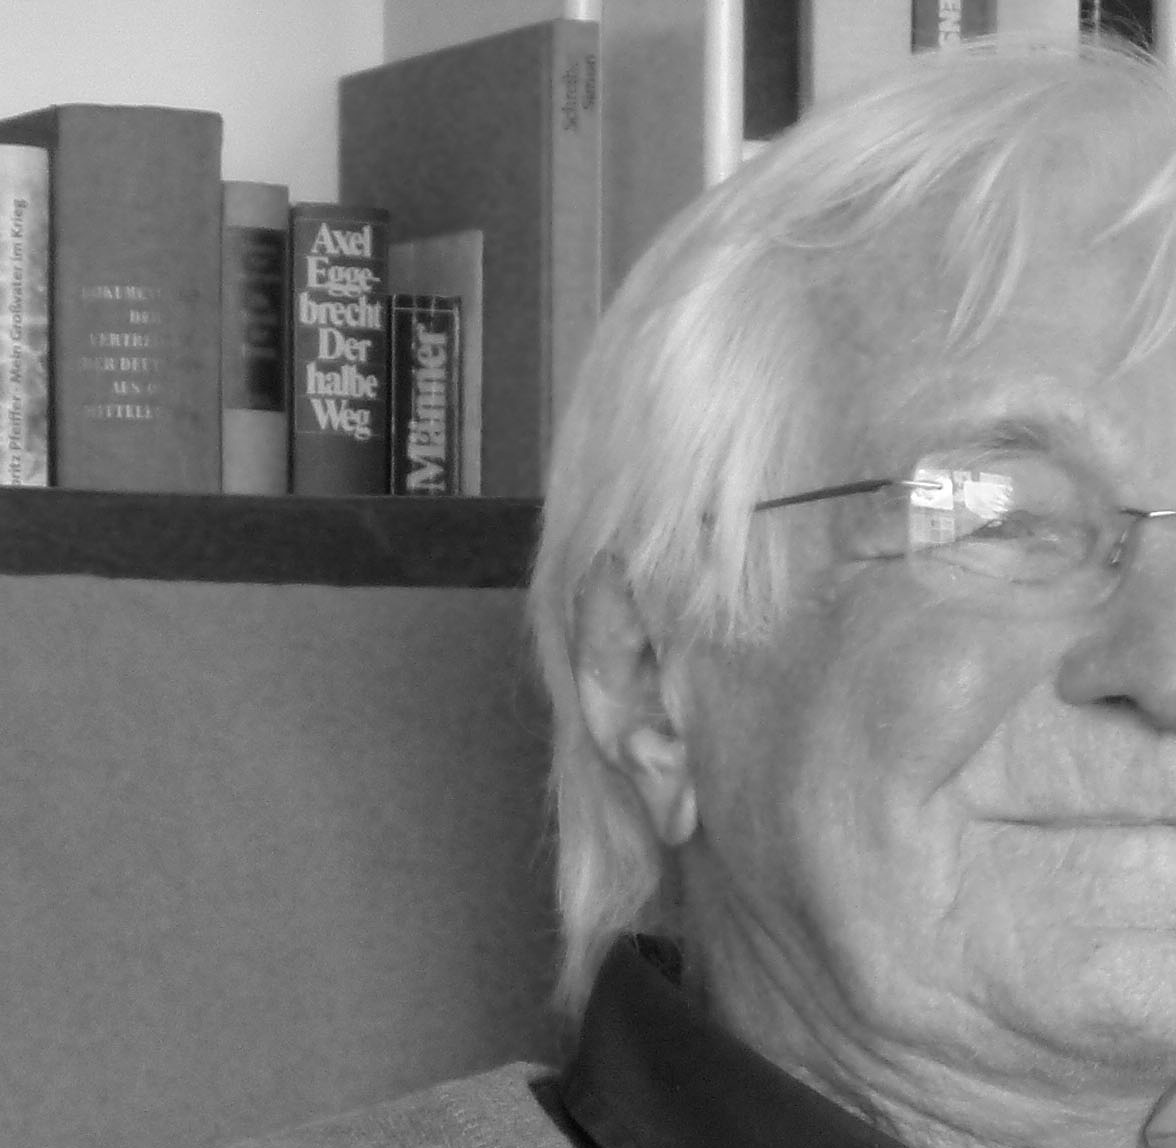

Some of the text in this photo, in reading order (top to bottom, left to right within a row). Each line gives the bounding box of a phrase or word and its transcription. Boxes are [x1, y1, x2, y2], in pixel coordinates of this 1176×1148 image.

[10, 198, 28, 240] Krieg
[10, 241, 23, 261] im
[311, 223, 373, 257] Axel
[306, 256, 381, 297] Egge-
[8, 265, 24, 341] Großvater
[300, 291, 382, 329] brecht
[9, 345, 22, 384] Mein
[317, 328, 373, 363] Der
[306, 362, 379, 398] halbe
[8, 394, 23, 451] Pfeiffer
[310, 398, 373, 440] Weg
[406, 323, 449, 494] Männer
